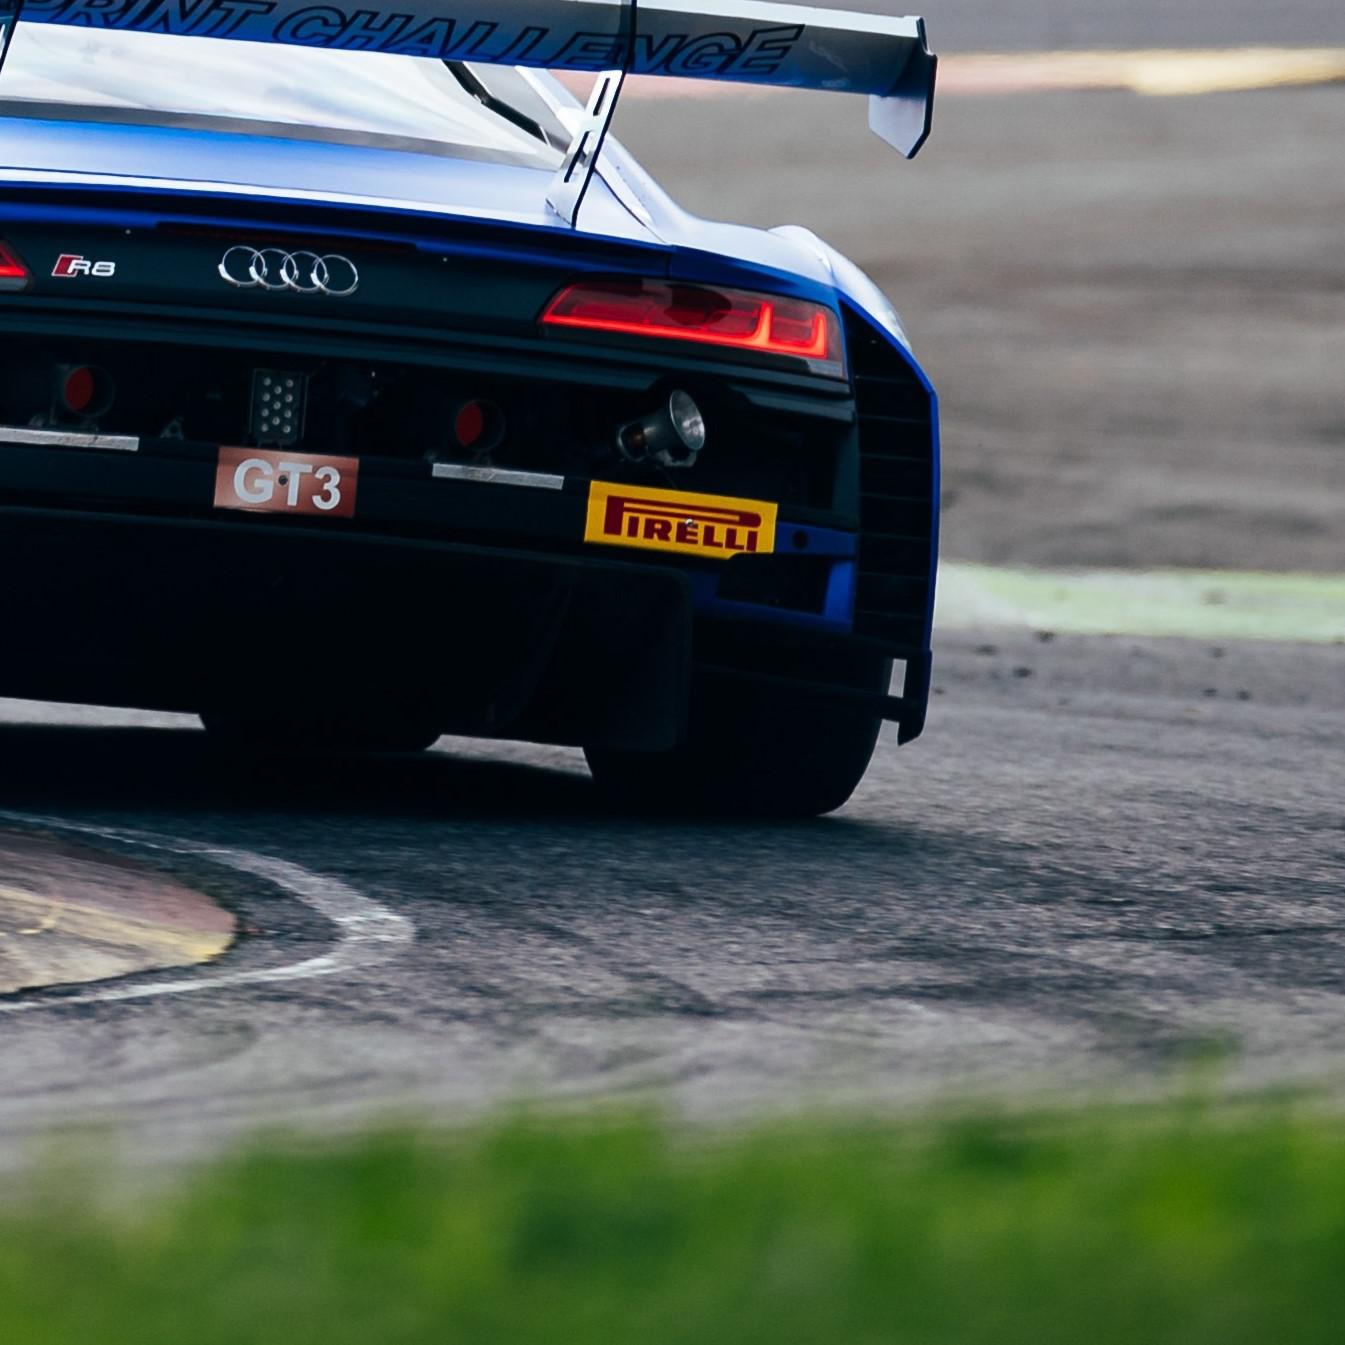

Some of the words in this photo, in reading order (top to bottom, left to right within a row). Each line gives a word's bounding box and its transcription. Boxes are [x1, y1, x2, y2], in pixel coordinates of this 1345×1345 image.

[270, 6, 806, 75] CHALLENGE
[66, 259, 116, 276] R8
[232, 457, 342, 510] GT3
[603, 495, 762, 553] PIRELLI
